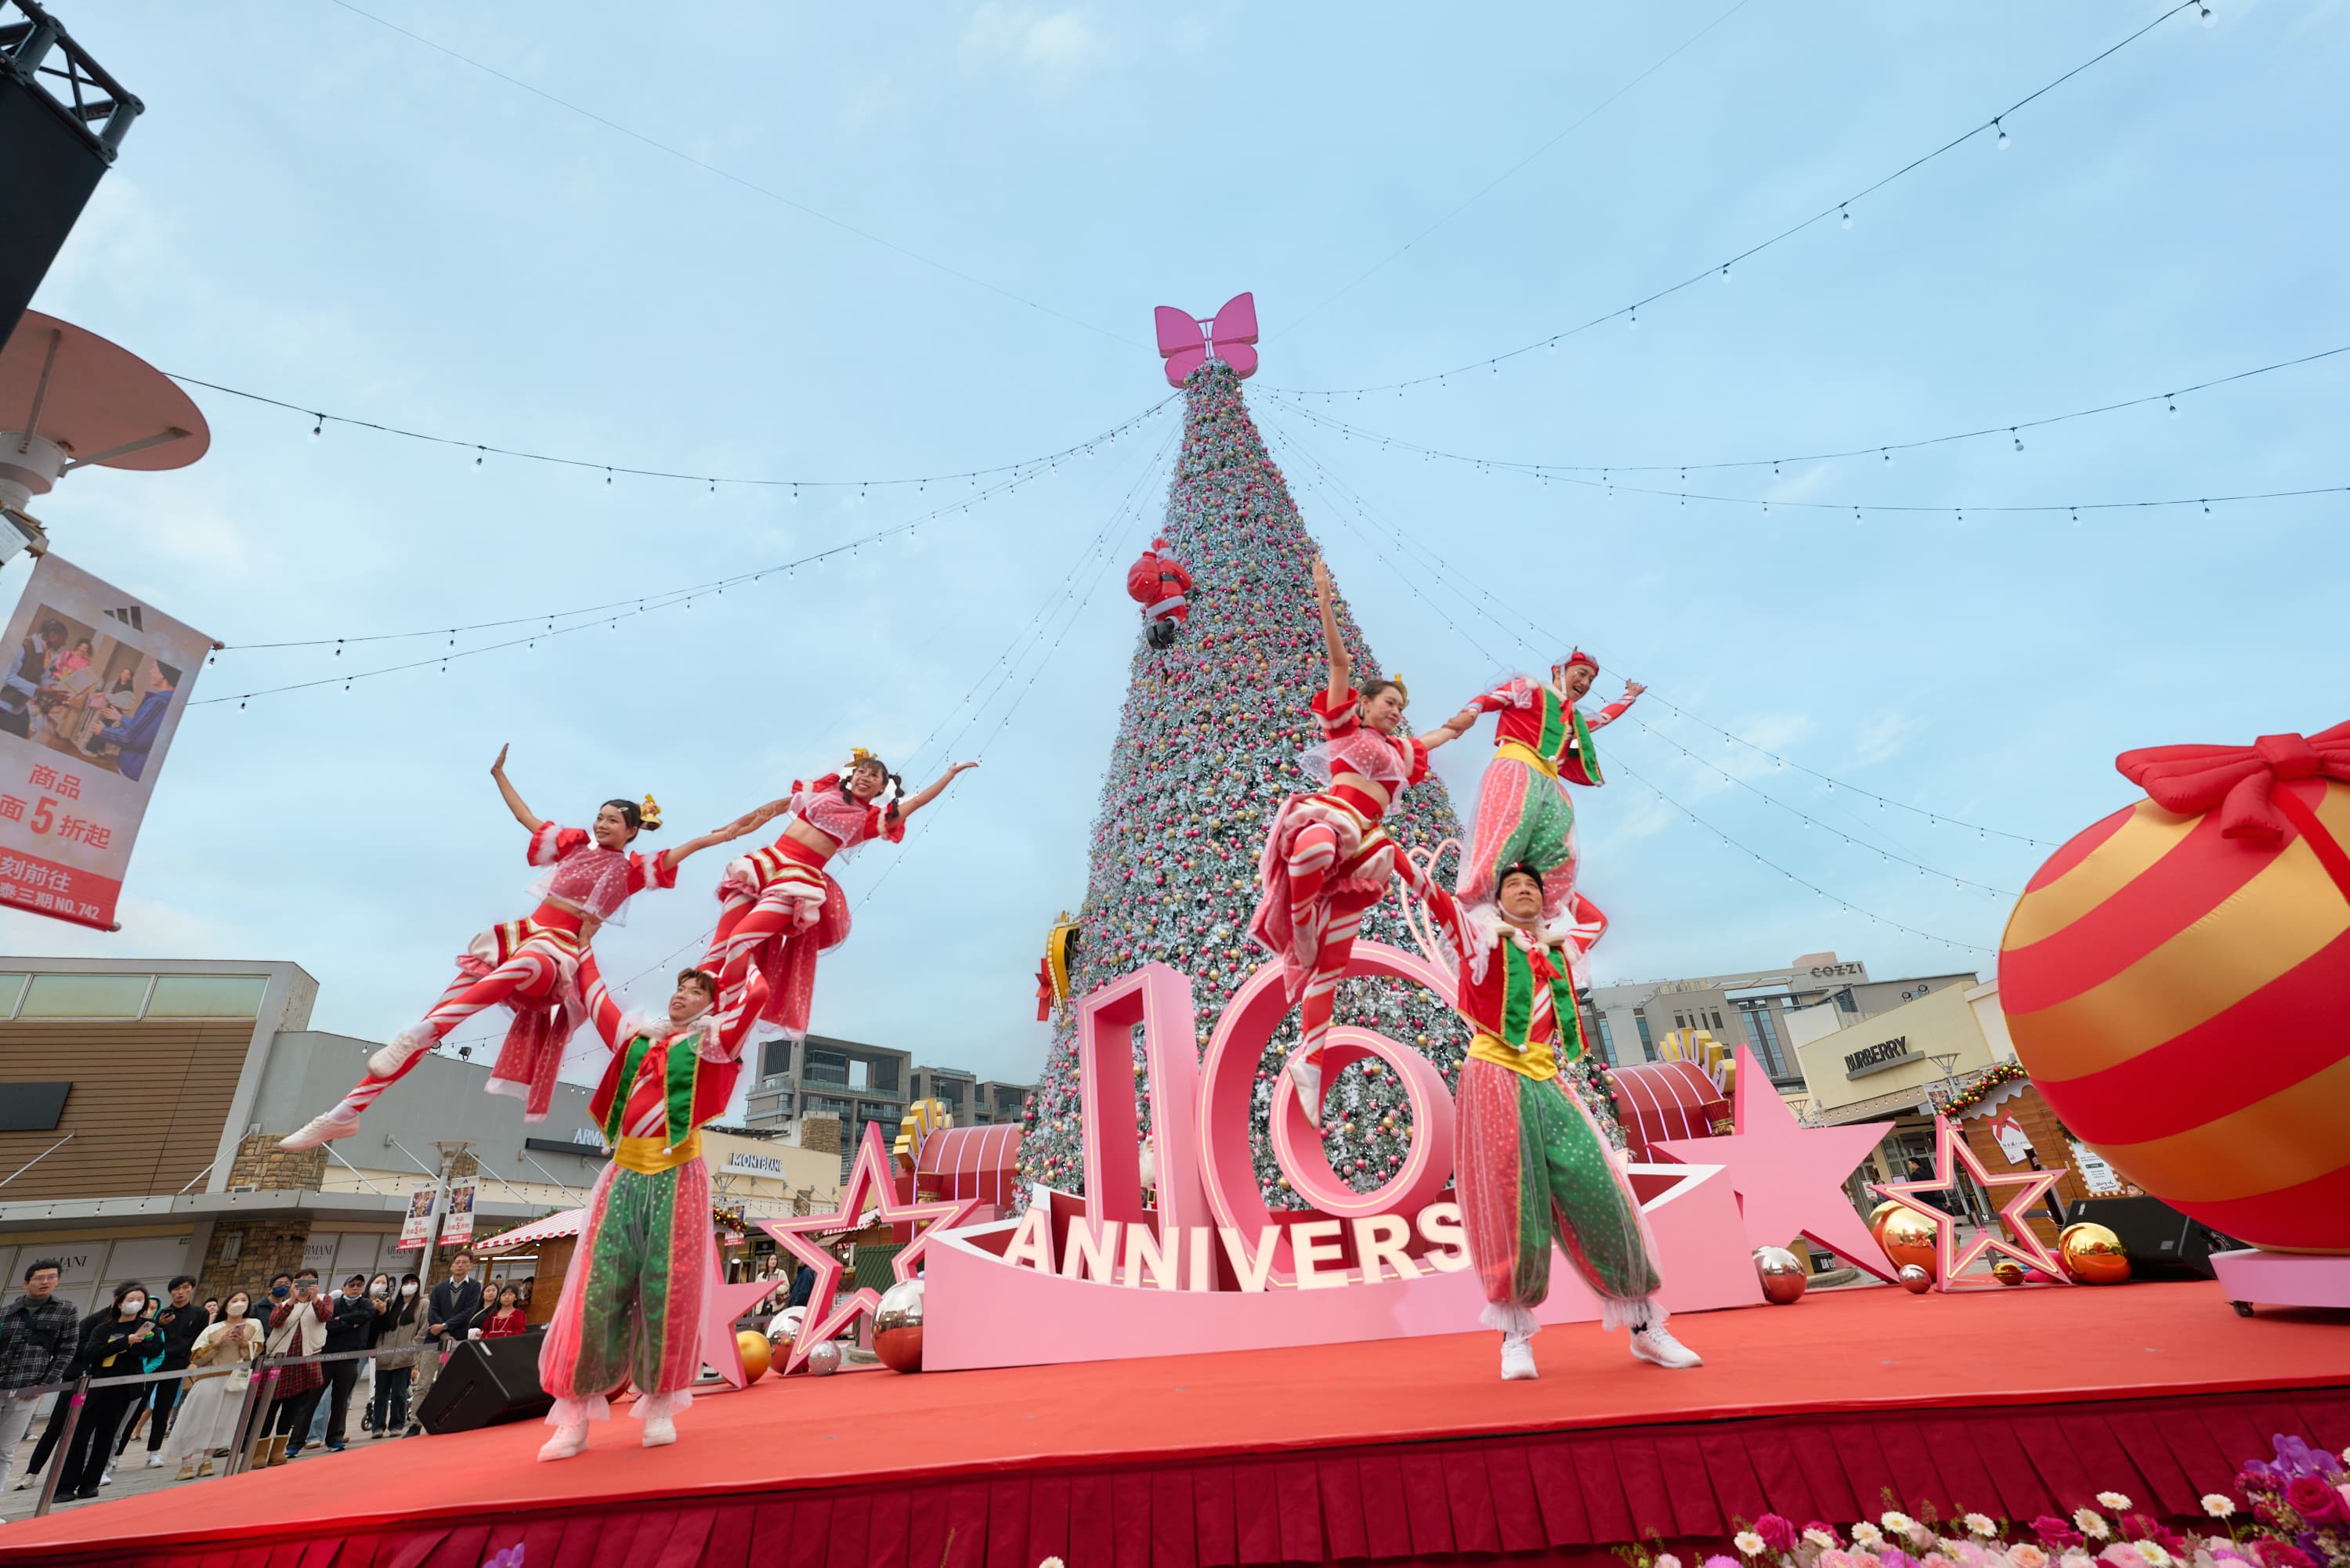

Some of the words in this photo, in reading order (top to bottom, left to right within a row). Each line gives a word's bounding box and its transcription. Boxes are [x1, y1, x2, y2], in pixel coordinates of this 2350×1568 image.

[28, 763, 82, 801] 商品
[0, 854, 73, 894] 刻前往
[1810, 963, 1864, 978] COZZI
[1844, 1035, 1909, 1072] BURBERRY
[573, 1127, 615, 1149] ARMA
[730, 1152, 783, 1173] MONTBLANC
